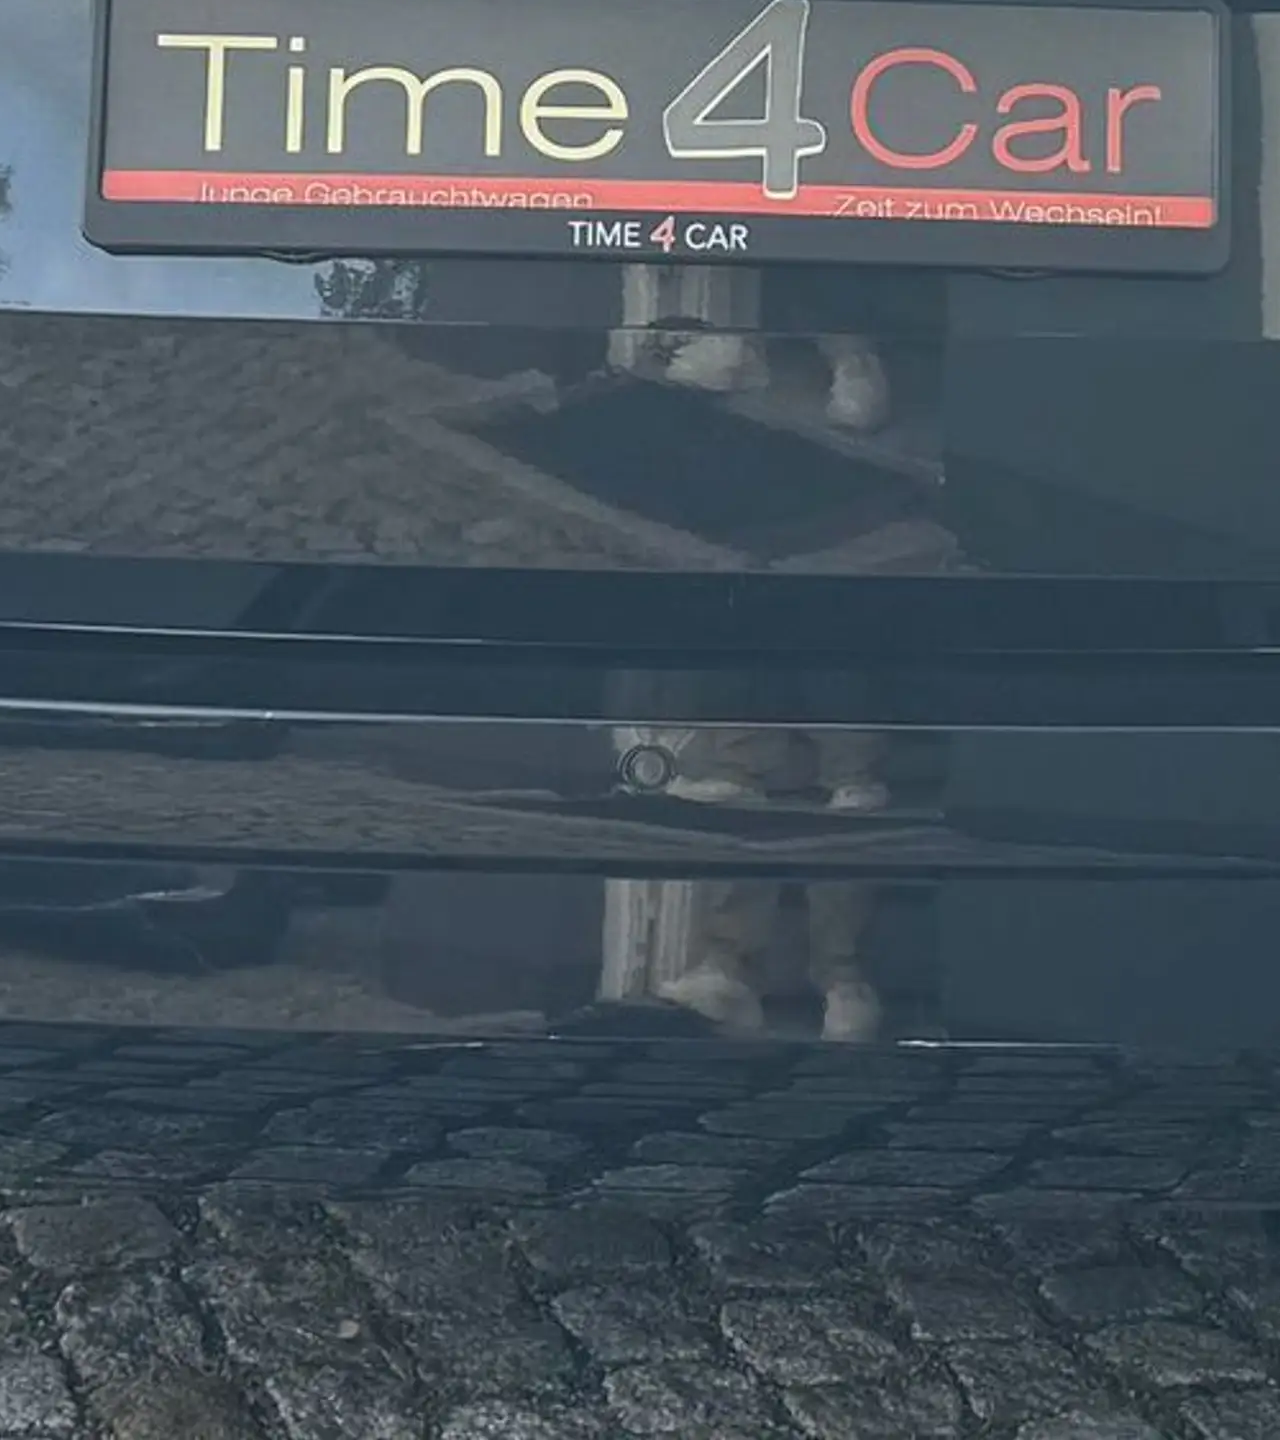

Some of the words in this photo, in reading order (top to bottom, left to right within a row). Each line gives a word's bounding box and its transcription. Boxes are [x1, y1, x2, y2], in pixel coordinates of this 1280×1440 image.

[157, 34, 629, 161] Time
[850, 46, 1161, 173] Car
[568, 220, 642, 248] TIME
[649, 215, 676, 253] 4
[684, 222, 749, 250] CAR
